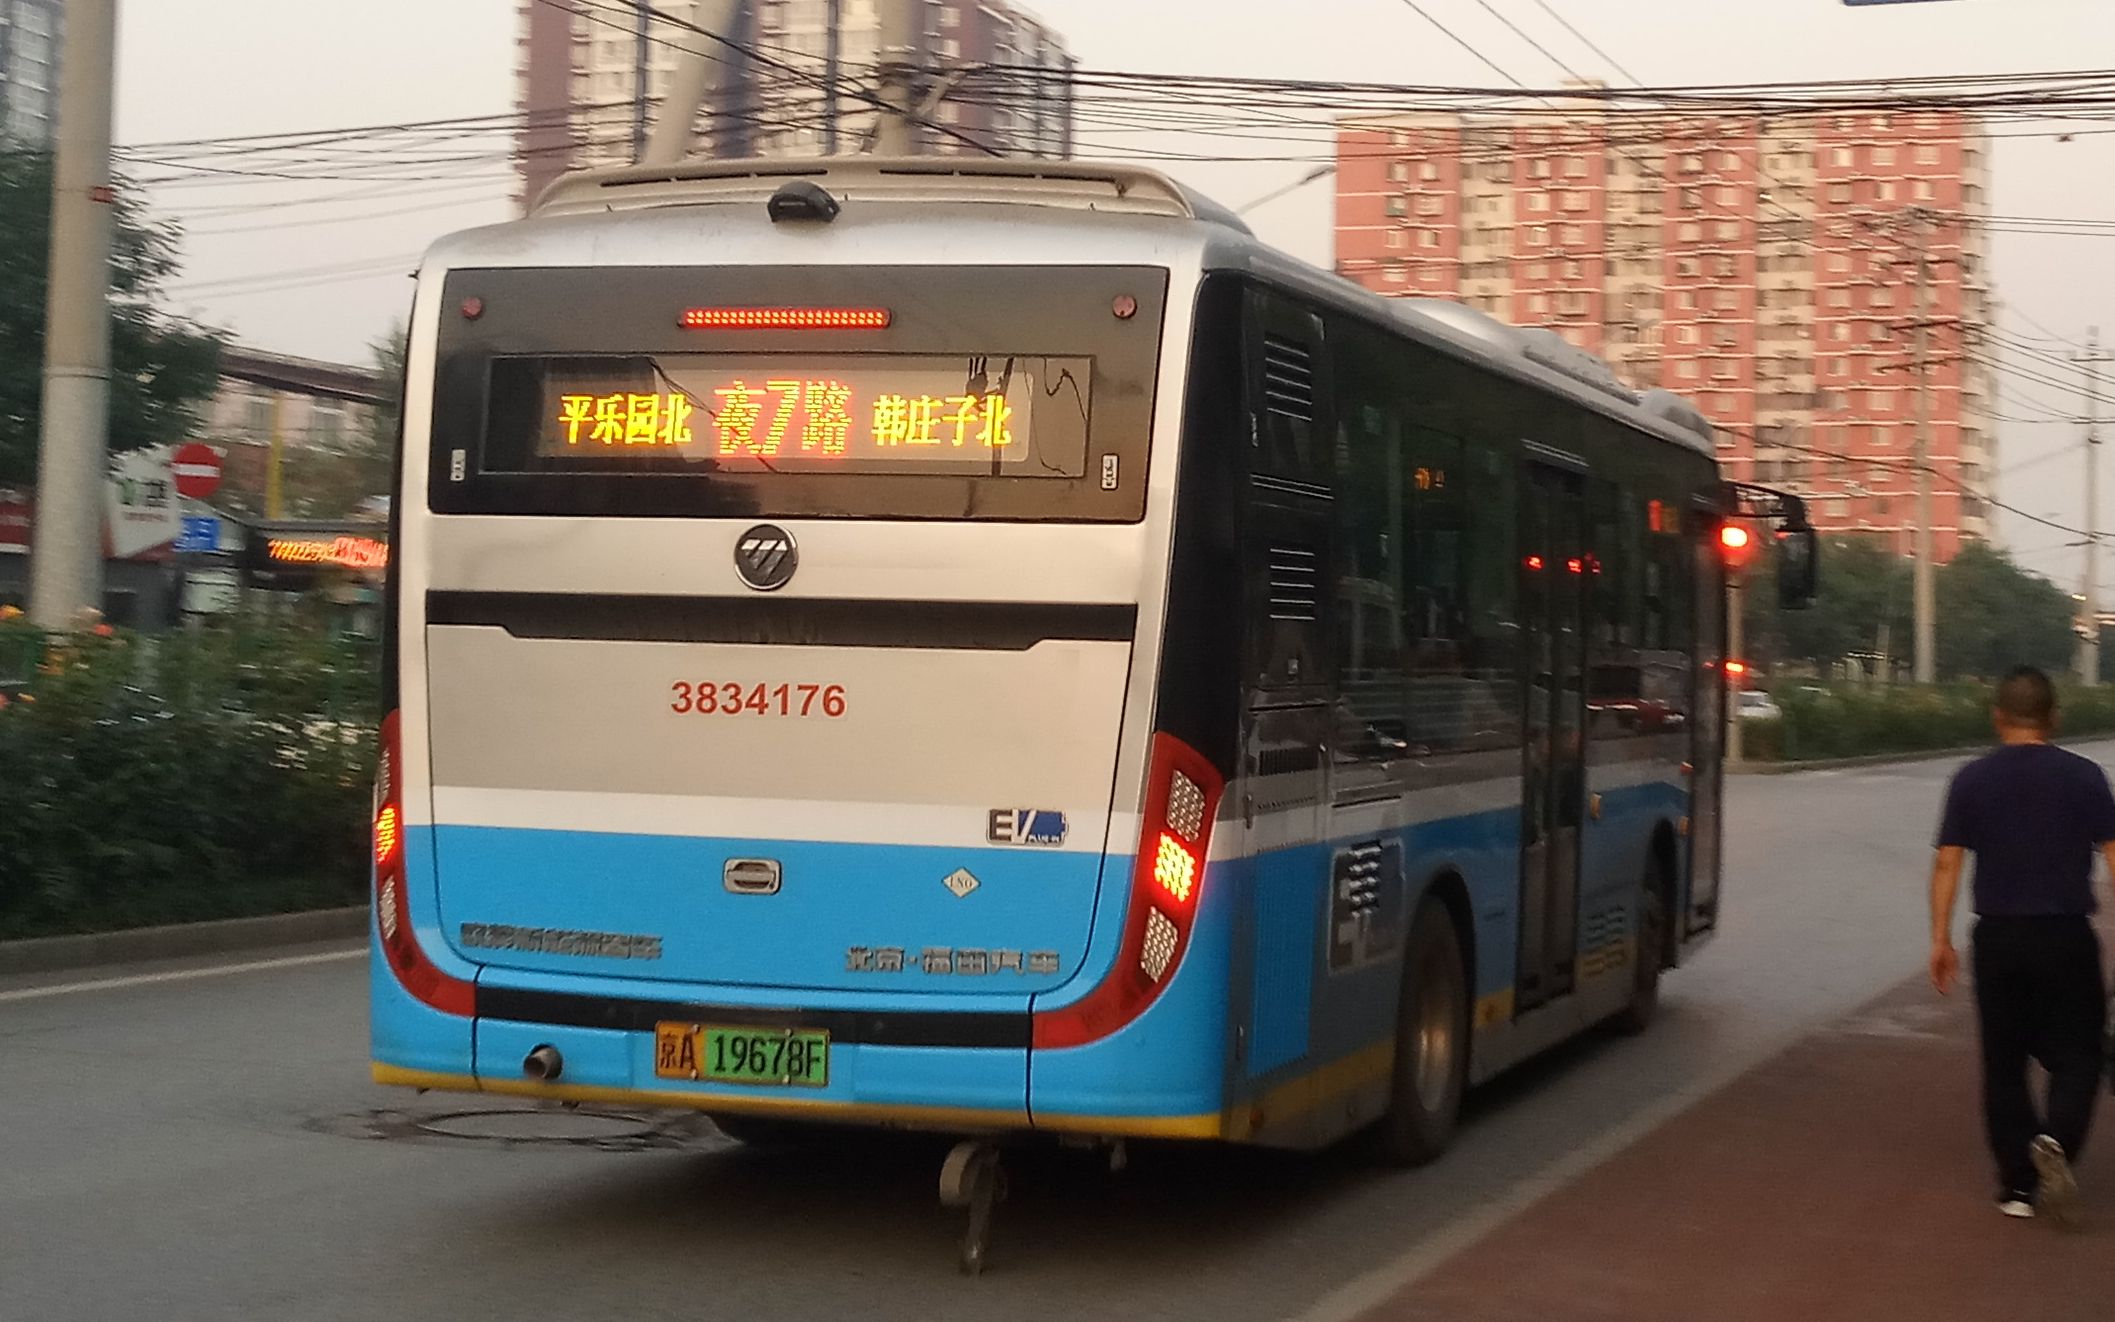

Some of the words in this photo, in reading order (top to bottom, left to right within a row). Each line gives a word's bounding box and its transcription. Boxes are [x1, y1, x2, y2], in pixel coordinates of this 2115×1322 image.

[558, 393, 693, 444] 平乐园北
[711, 379, 852, 455] 夜7路
[870, 394, 1012, 448] 韩庄子北
[670, 680, 846, 717] 3834176
[989, 808, 1038, 845] EV
[713, 1033, 823, 1079] 19678F
